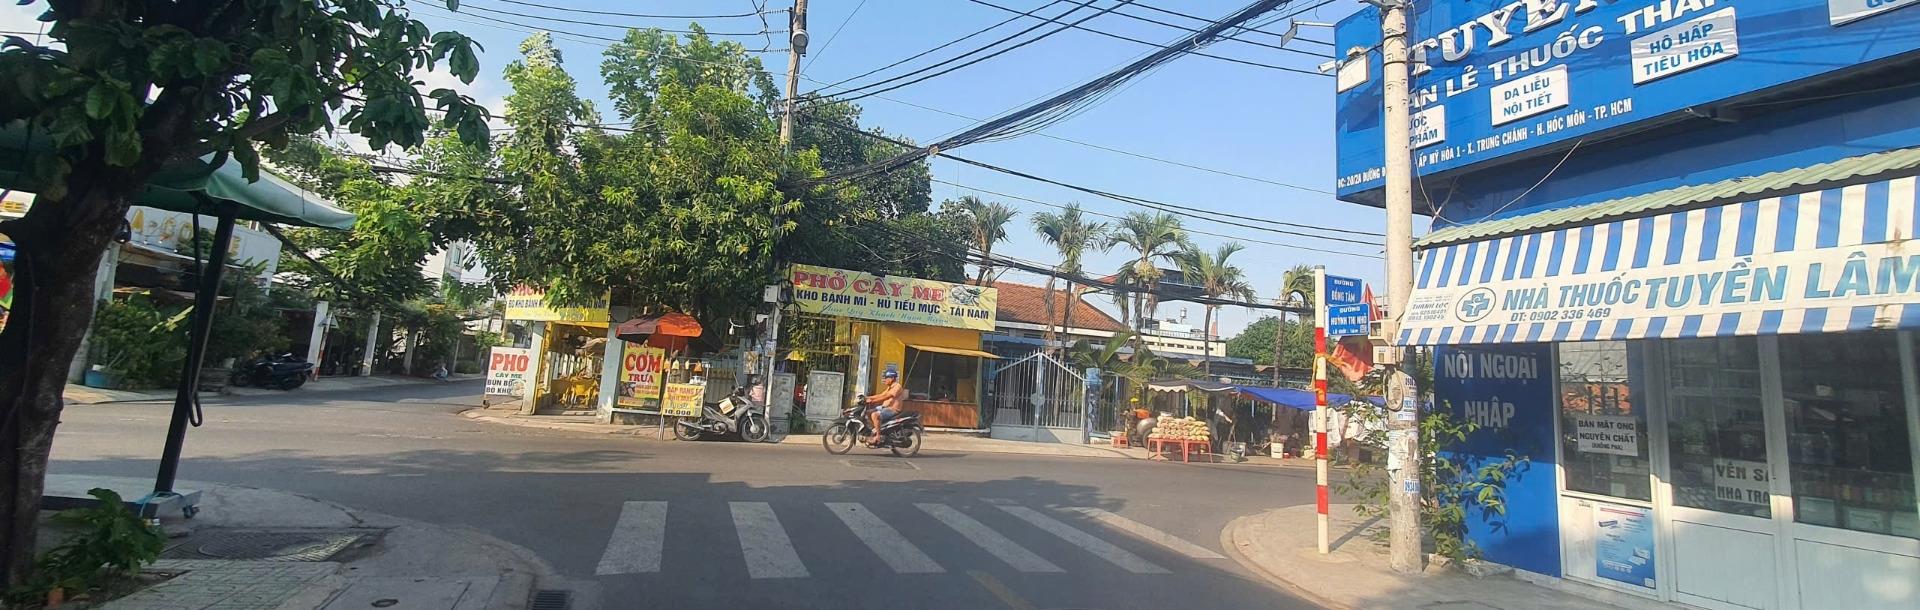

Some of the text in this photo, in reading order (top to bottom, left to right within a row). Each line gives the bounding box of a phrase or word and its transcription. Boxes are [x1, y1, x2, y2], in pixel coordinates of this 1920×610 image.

[1678, 21, 1714, 45] HẤP
[1409, 85, 1437, 107] ÁN
[1446, 64, 1478, 98] LẺ
[1488, 23, 1604, 80] THUỐC
[1643, 42, 1723, 75] TIÊU HÓA
[1504, 75, 1550, 100] DA LIỄU
[1503, 91, 1552, 116] NỘI TIẾT
[1418, 151, 1427, 168] ẤP
[1429, 149, 1439, 164] MỸ
[1456, 146, 1461, 158] 1
[1467, 142, 1474, 154] X.
[1477, 135, 1500, 152] TRUNG
[1502, 127, 1528, 145] CHÁNH
[1536, 123, 1545, 136] H.
[1547, 115, 1564, 134] HÓC
[1566, 110, 1585, 128] MÔN
[1594, 105, 1608, 120] TP.
[1610, 97, 1632, 116] HCM
[793, 270, 945, 302] PHỞ CÂY ME
[1334, 279, 1354, 287] ĐƯỜNG
[1501, 272, 1641, 311] NHÀ THUỐC
[1645, 250, 1920, 309] TUYỀN LÂM
[796, 289, 818, 301] KHO
[821, 291, 851, 305] BÁNH
[853, 295, 867, 306] MÌ
[877, 296, 891, 309] HỦ
[894, 298, 915, 311] TIẾU
[918, 302, 940, 315] MỰC
[950, 305, 964, 316] TÁI
[967, 308, 989, 320] NẠM
[1345, 290, 1356, 302] TÂM
[1510, 307, 1611, 322] ĐT: 0902 336 469
[490, 350, 529, 371] PHỞ
[625, 351, 662, 373] CƠM
[1444, 350, 1474, 384] NỘI
[628, 373, 654, 383] TRƯA
[1464, 396, 1515, 433] NHẬP
[1616, 422, 1634, 430] ONG
[1579, 432, 1635, 443] NGUYÊN CHẤT
[1717, 486, 1742, 500] NHA
